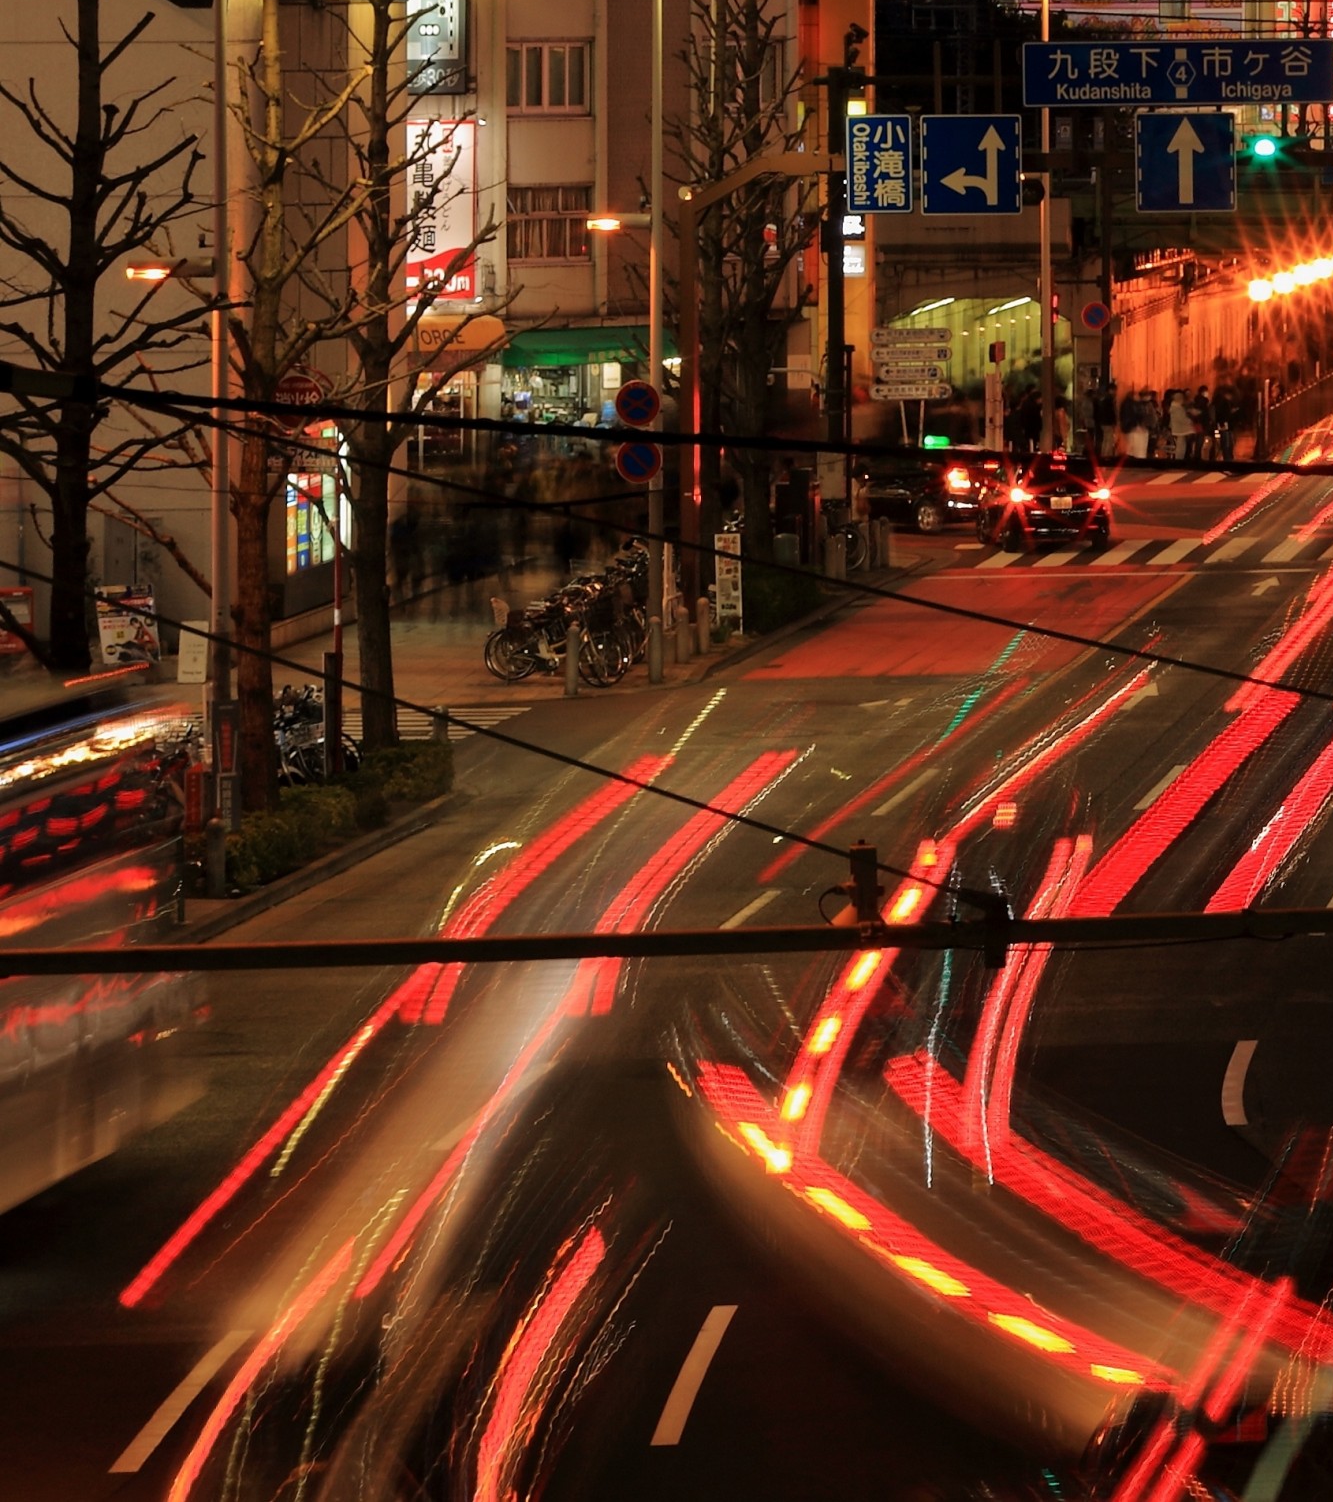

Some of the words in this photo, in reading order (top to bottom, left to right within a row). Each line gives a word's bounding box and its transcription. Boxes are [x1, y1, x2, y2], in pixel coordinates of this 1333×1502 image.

[1047, 47, 1160, 81] 九段下
[1056, 83, 1152, 100] Kudanshita
[1220, 81, 1293, 101] Ichigaya
[851, 122, 871, 206] Otakibashi
[872, 120, 906, 208] 小滝橋
